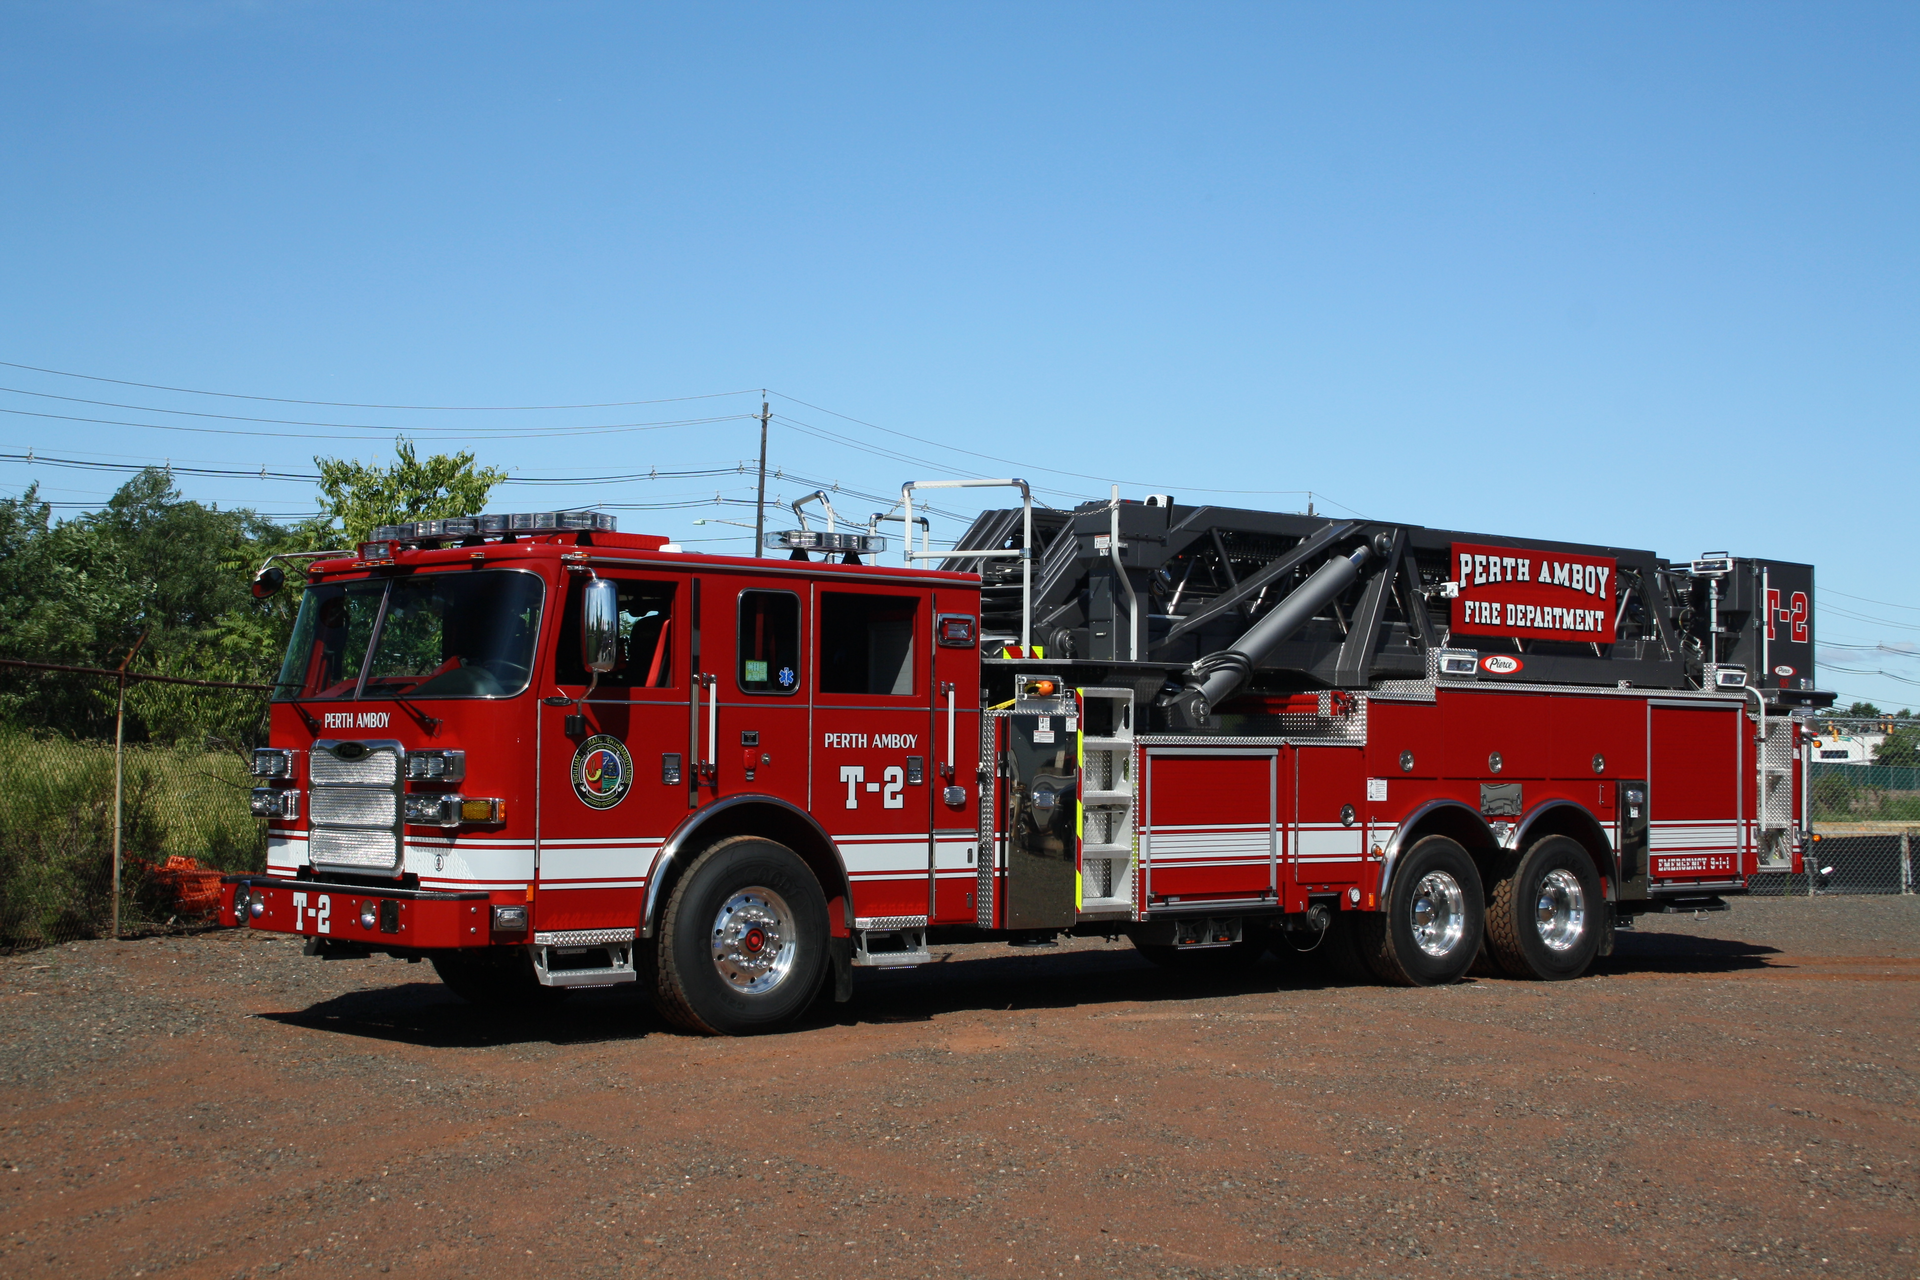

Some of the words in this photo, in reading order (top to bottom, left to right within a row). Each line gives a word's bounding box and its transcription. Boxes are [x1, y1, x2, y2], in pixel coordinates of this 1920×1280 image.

[1459, 553, 1530, 590] PERTH
[1538, 560, 1610, 600] AMBOY
[1464, 600, 1501, 626] FIRE
[1506, 603, 1605, 633] DEPARTMENT
[1760, 588, 1807, 643] T-2
[1489, 657, 1513, 670] Pierce
[324, 712, 354, 729] PERTH
[355, 712, 391, 729] AMBOY
[824, 732, 868, 749] PERTH
[871, 733, 919, 749] AMBOY
[840, 765, 904, 809] T-2
[1658, 857, 1708, 872] EMERGENCY
[1710, 856, 1730, 870] 9-1-1
[293, 891, 331, 934] T-2
